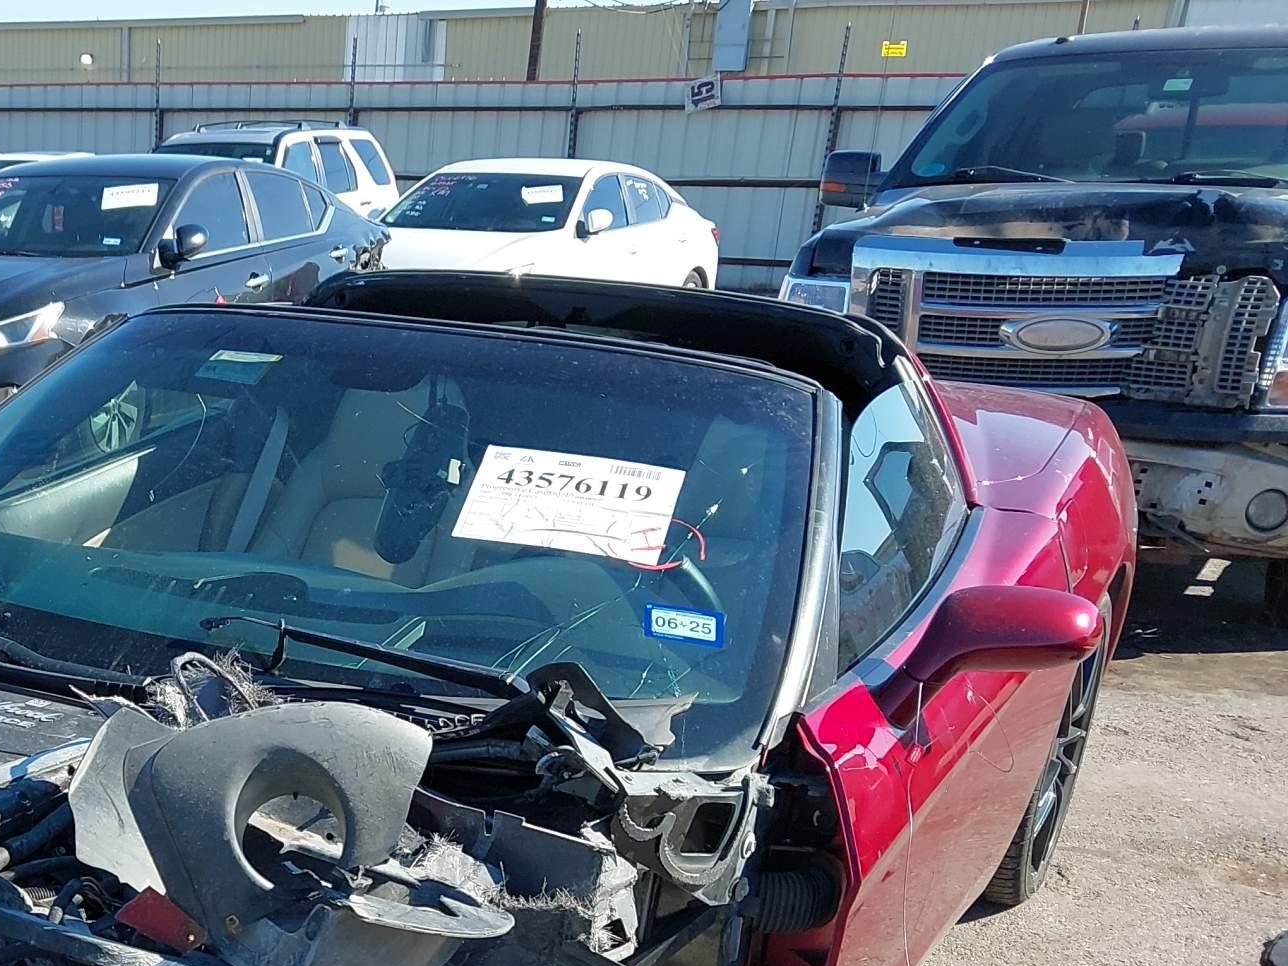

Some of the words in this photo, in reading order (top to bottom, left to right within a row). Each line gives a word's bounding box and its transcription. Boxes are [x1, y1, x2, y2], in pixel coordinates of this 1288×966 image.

[497, 468, 653, 501] 43576119
[654, 616, 678, 629] 06
[688, 620, 712, 635] 25
